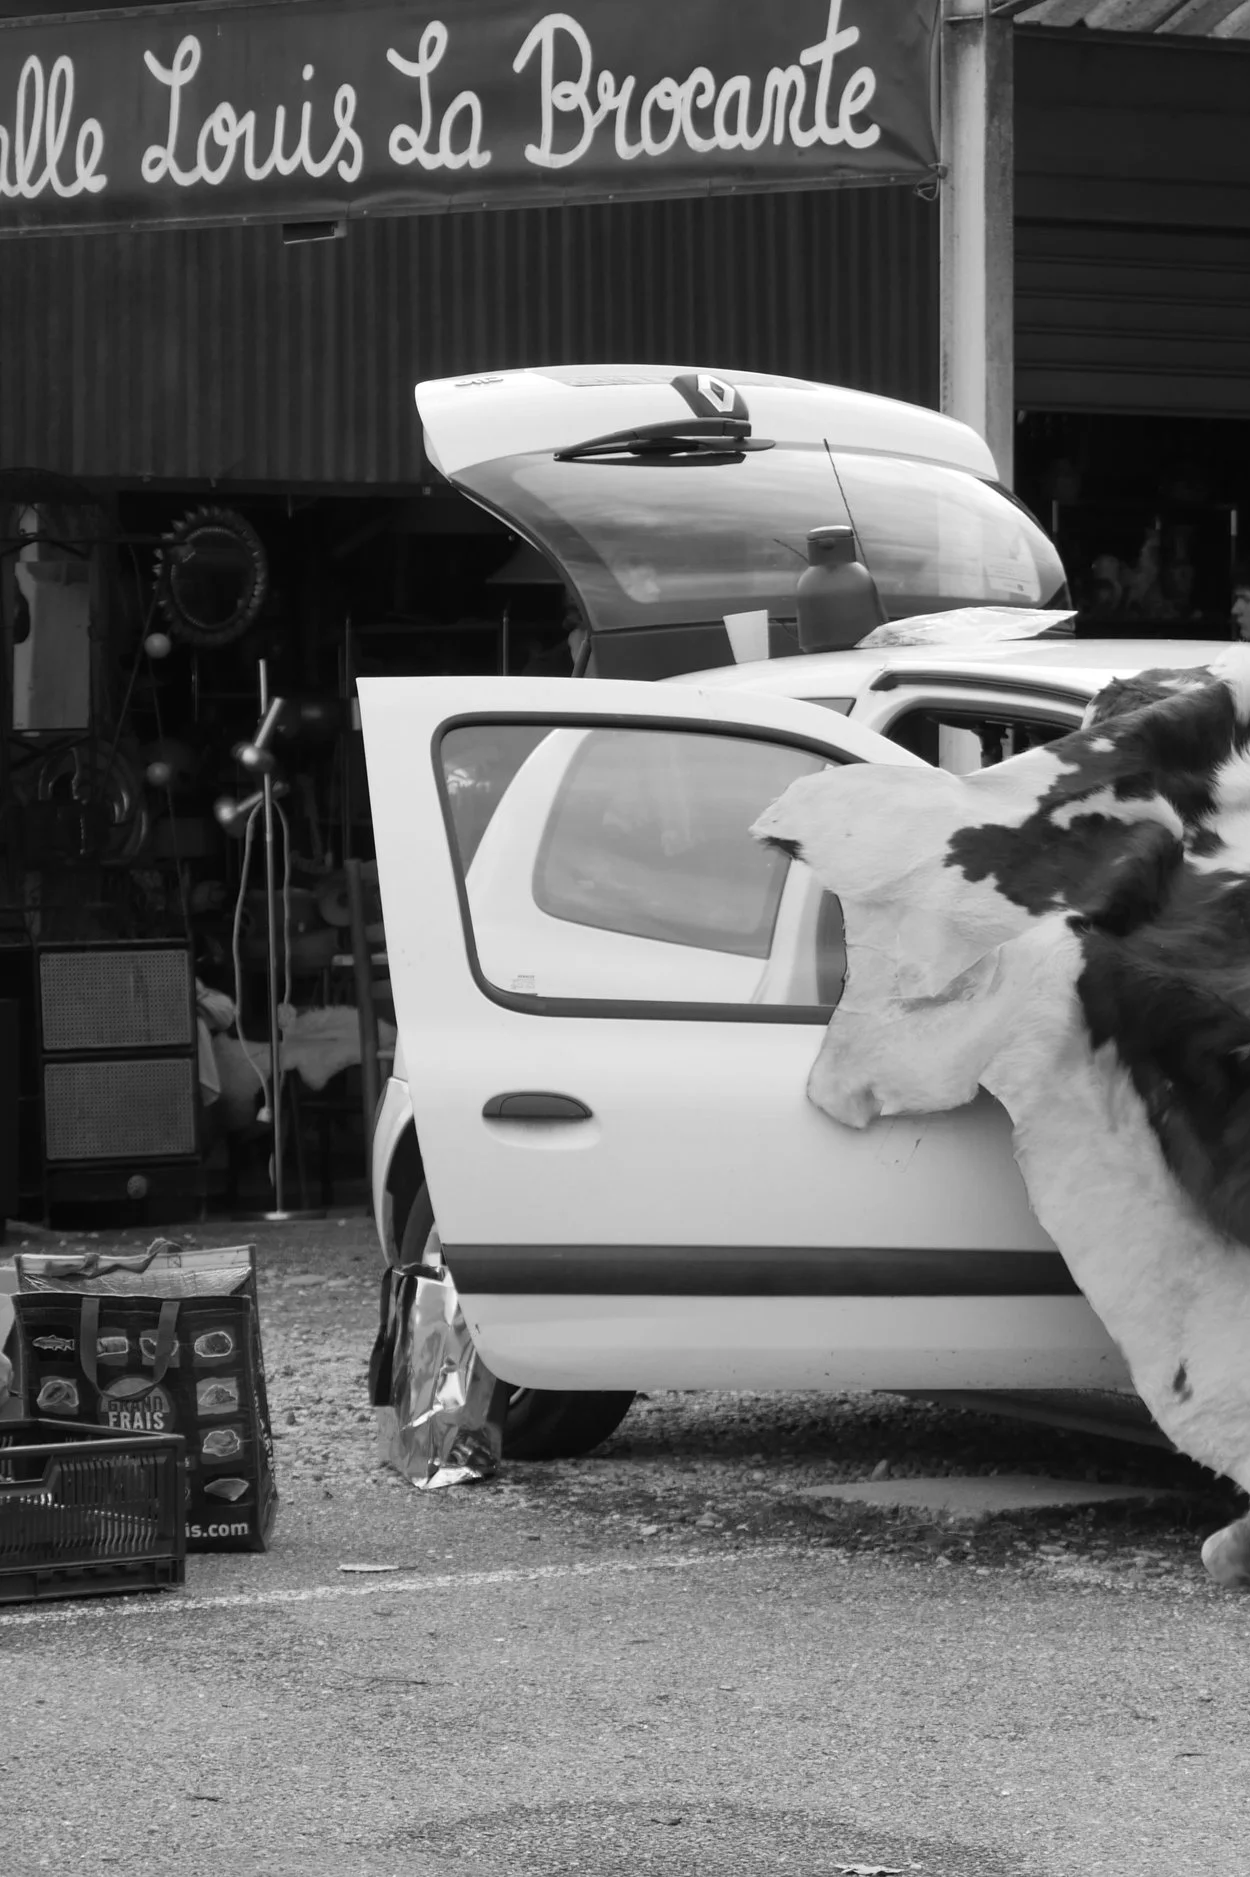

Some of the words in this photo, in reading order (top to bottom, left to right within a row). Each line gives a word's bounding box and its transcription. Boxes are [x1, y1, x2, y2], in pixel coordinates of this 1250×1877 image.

[141, 35, 364, 187] Louis
[387, 20, 491, 171] La
[513, 0, 880, 168] Brocante
[107, 1396, 163, 1412] GRAND
[108, 1411, 164, 1430] FRAIS
